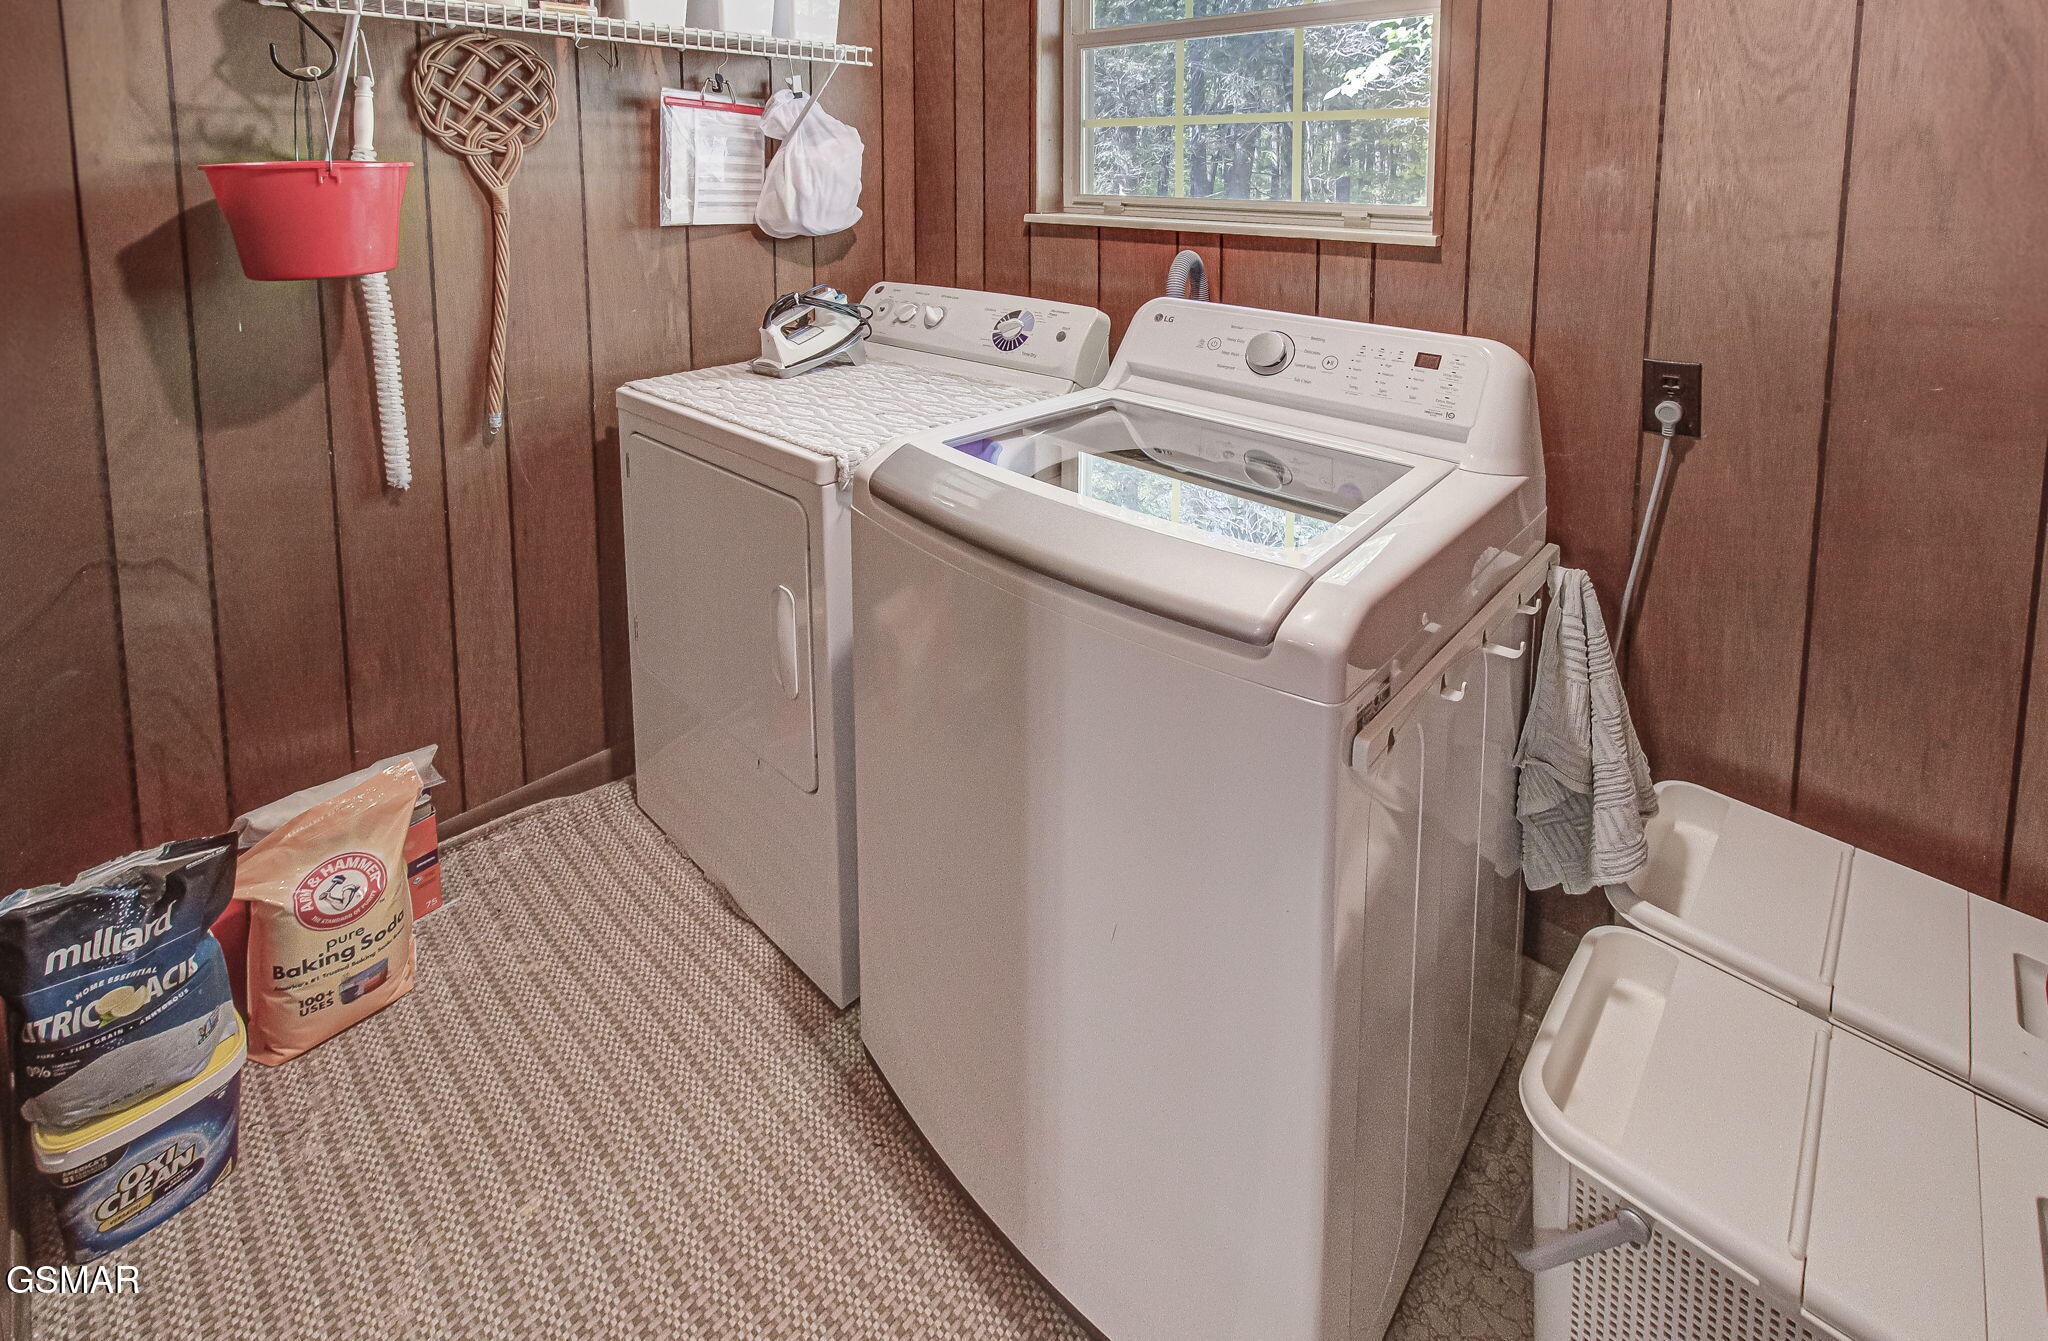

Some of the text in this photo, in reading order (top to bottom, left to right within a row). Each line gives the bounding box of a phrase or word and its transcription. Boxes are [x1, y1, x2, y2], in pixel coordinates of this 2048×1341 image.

[307, 877, 320, 888] &
[321, 856, 382, 890] HAMMER
[44, 900, 177, 976] milliard
[272, 910, 405, 979] Baking Soda
[326, 927, 366, 952] pure
[75, 980, 105, 1000] HOME
[107, 966, 158, 984] ESSENTIAL
[322, 964, 350, 978] Trusted
[299, 989, 335, 1009] 100+
[299, 998, 335, 1017] USES
[94, 1028, 124, 1045] GRAIN
[97, 1145, 196, 1220] CLEAN
[118, 1143, 178, 1191] OXI
